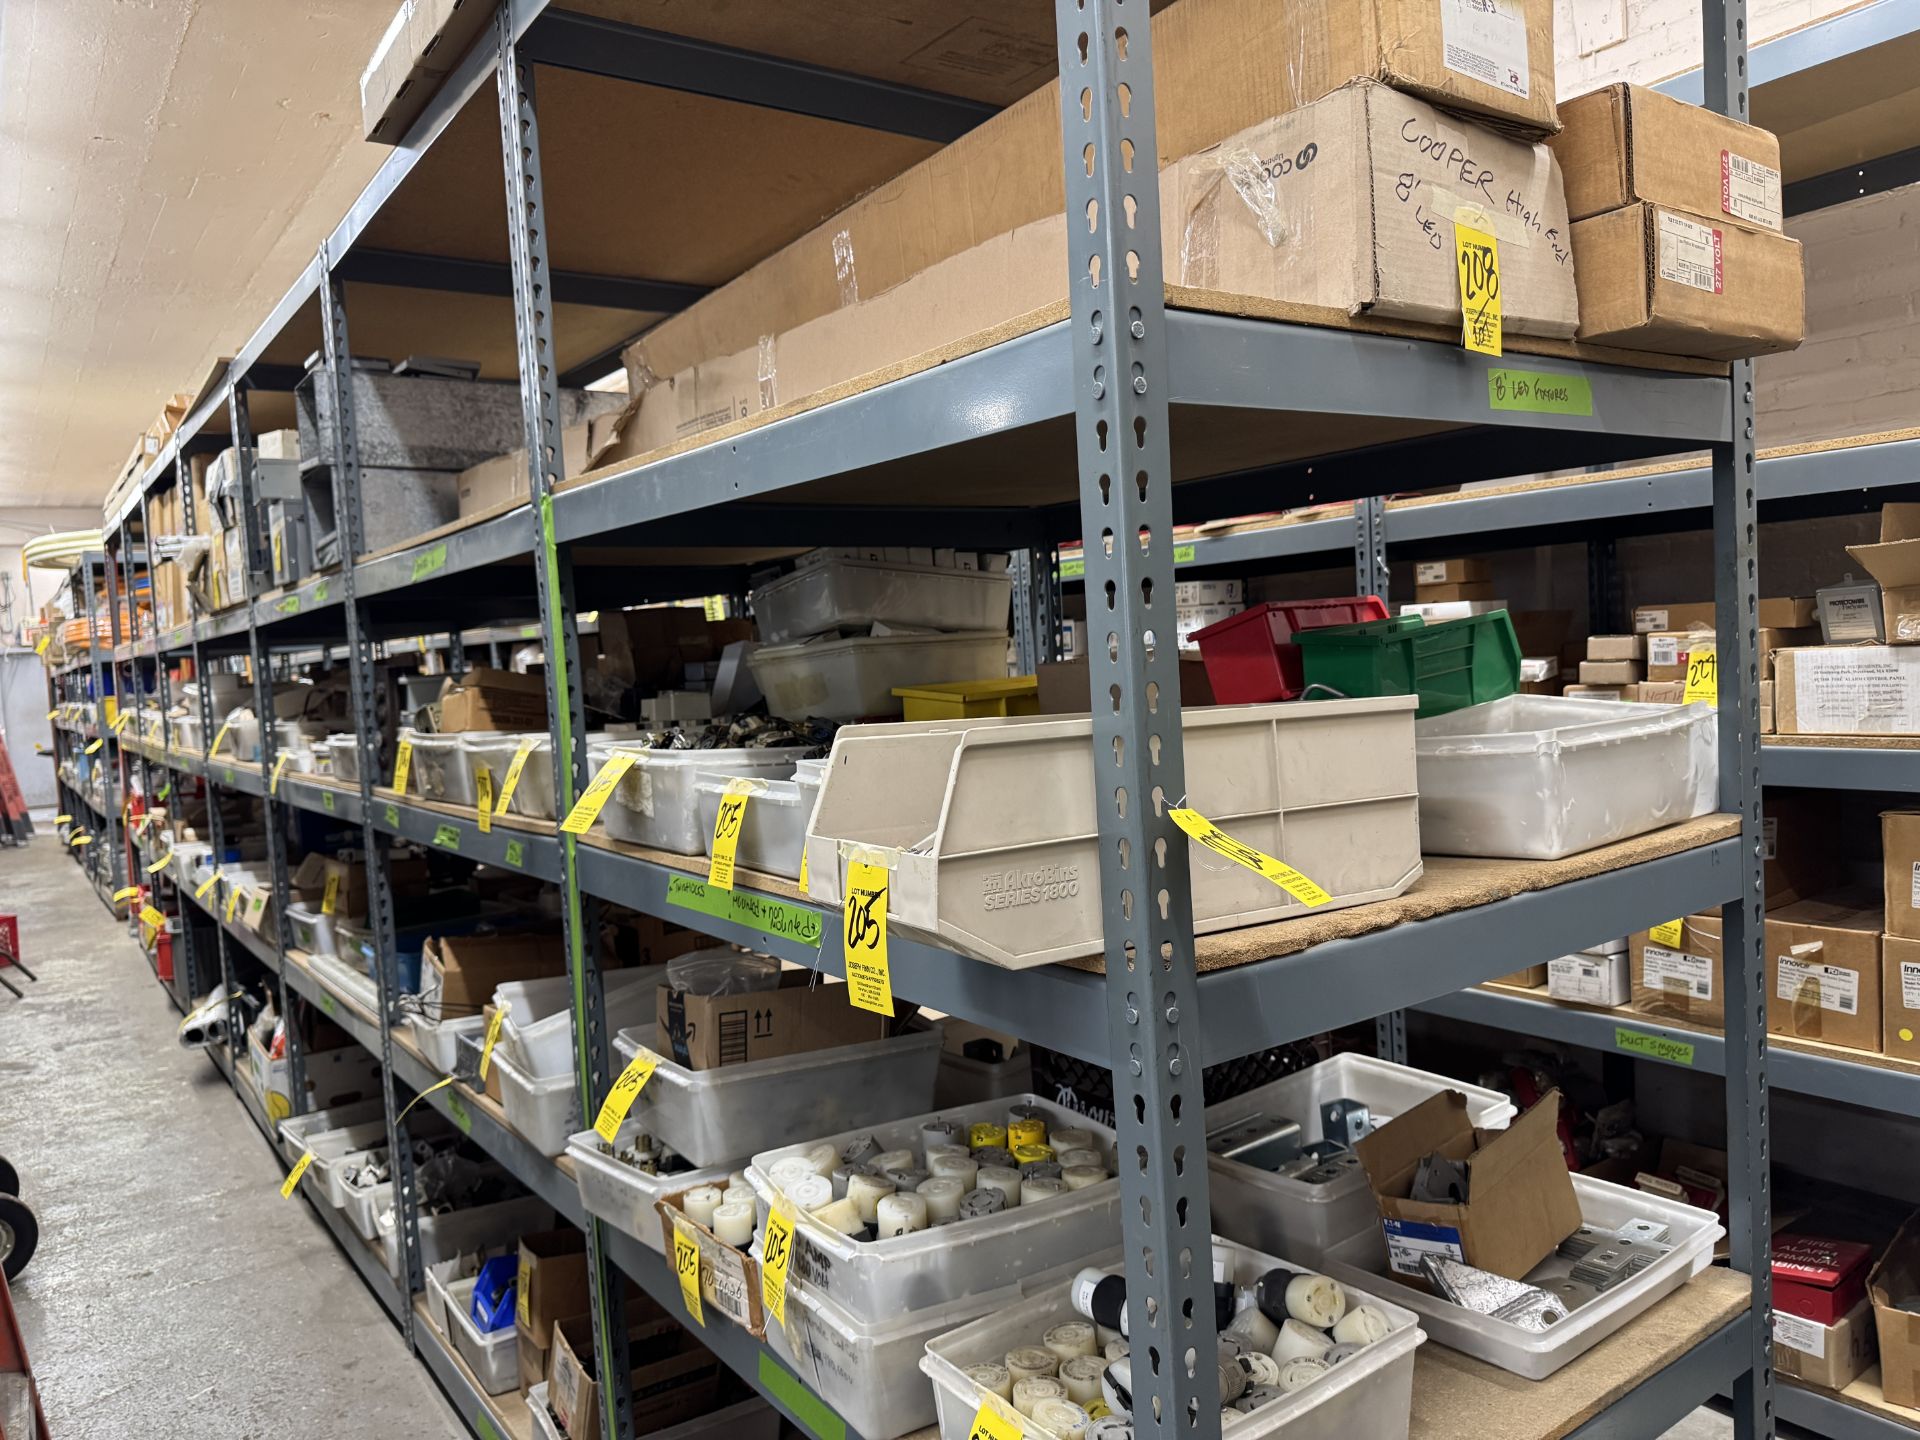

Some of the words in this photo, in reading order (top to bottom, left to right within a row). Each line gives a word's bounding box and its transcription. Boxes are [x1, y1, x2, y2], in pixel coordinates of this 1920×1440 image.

[1401, 117, 1495, 205] COOPER
[1416, 206, 1442, 250] LED
[1713, 235, 1721, 265] VOLT
[1461, 249, 1498, 301] 208
[1714, 269, 1722, 290] 277
[1512, 381, 1530, 400] LED
[715, 801, 742, 839] 205
[851, 887, 860, 895] LOT
[1004, 864, 1079, 892] AkroBins
[984, 887, 1041, 912] SERIES
[1043, 880, 1079, 901] 1800
[848, 887, 887, 950] 205
[616, 1068, 650, 1092] 205
[765, 1226, 788, 1270] 205
[805, 1239, 831, 1273] AMP
[1779, 1244, 1838, 1256] ALARM
[1798, 1239, 1837, 1249] FIRE
[677, 1246, 696, 1276] 205
[978, 1424, 989, 1436] LOT
